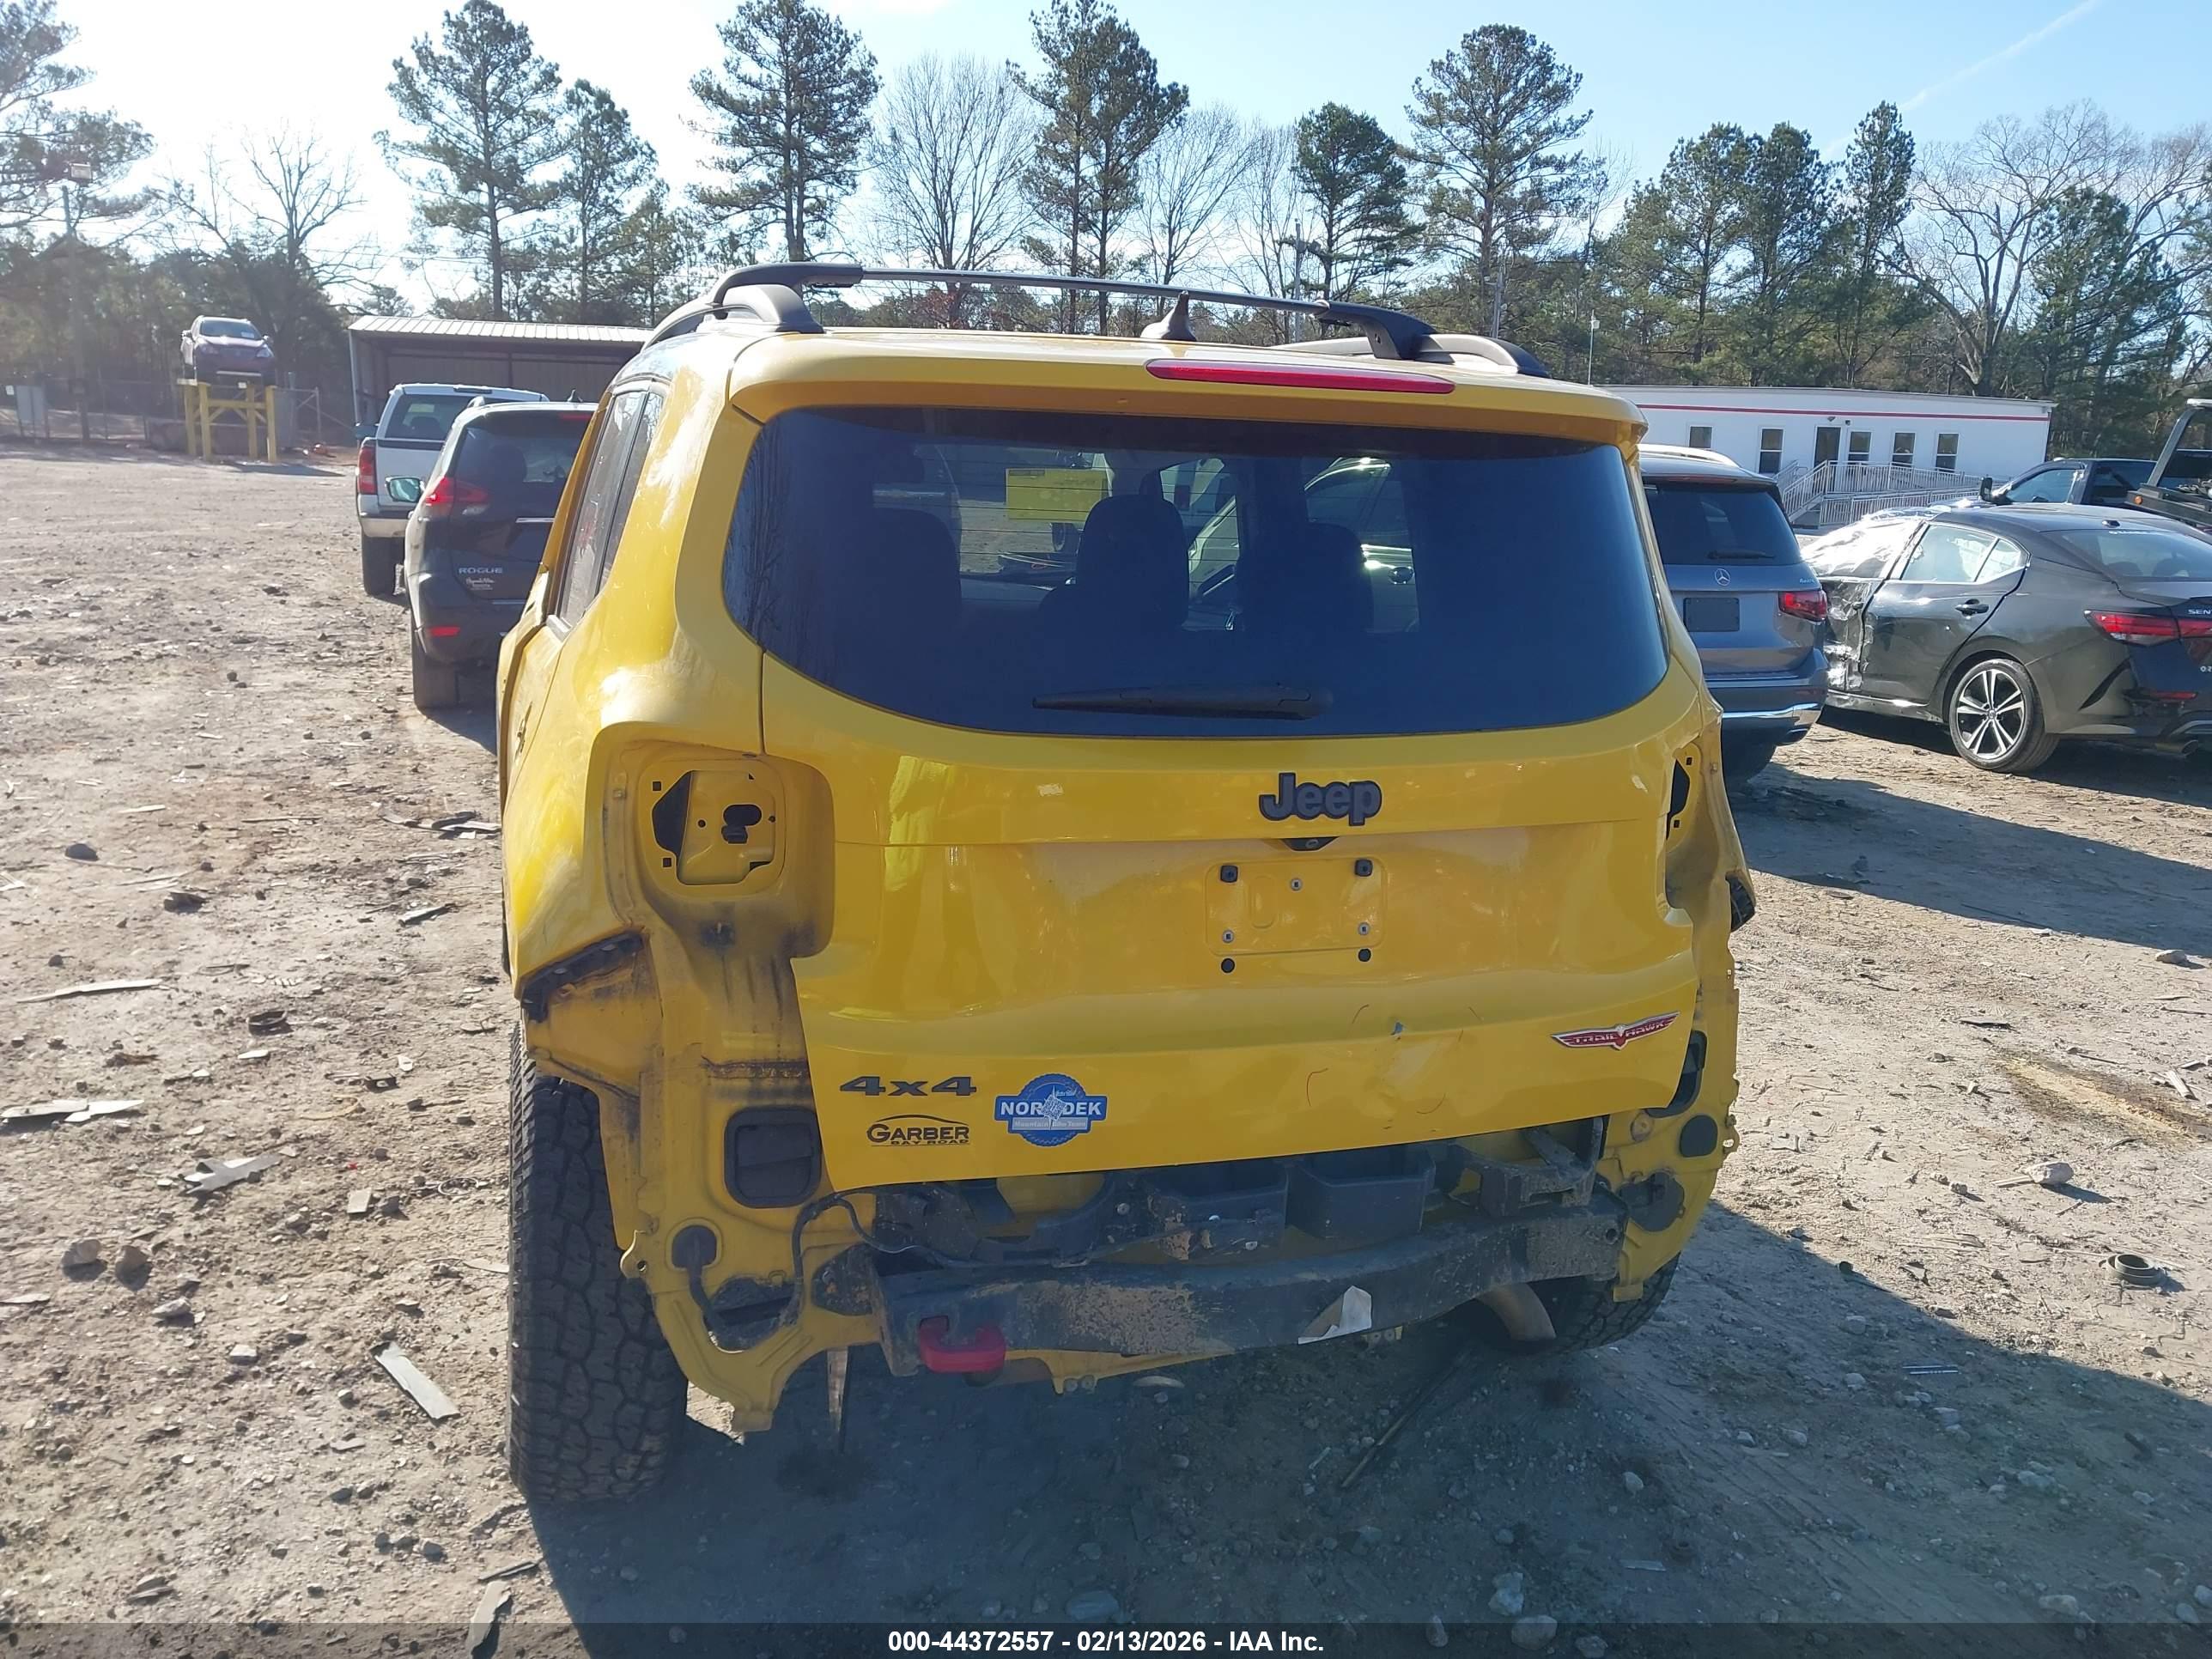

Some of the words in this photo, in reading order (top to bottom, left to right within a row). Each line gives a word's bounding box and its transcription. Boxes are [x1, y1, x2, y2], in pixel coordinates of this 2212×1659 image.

[1259, 772, 1382, 826] Jeep
[840, 1076, 977, 1097] 4x4
[866, 1123, 969, 1143] GARBER
